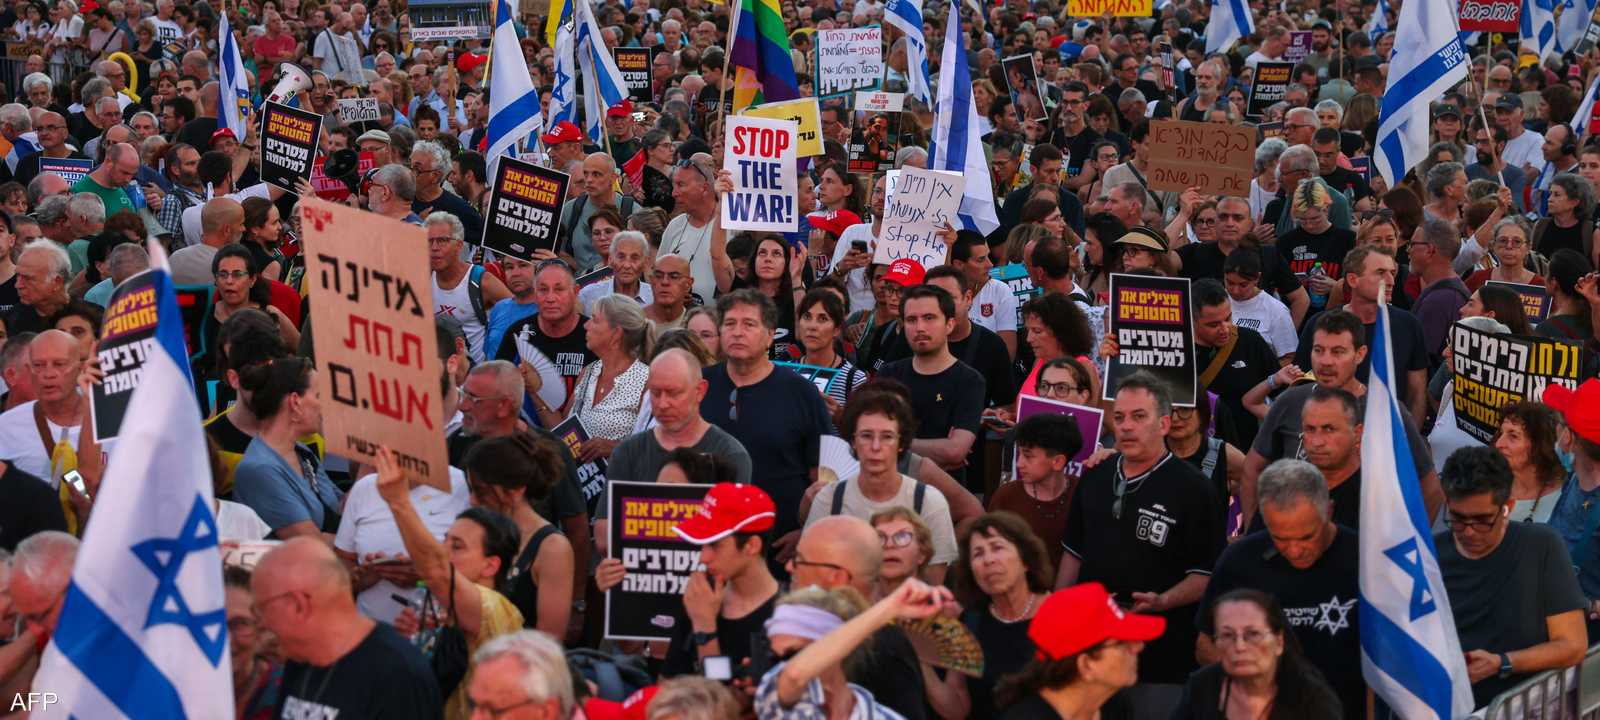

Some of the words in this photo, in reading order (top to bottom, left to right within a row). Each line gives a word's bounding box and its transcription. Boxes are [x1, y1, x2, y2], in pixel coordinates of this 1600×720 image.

[271, 112, 283, 122] את
[284, 115, 313, 132] מצילים
[269, 122, 311, 142] החטופים
[733, 126, 789, 158] STOP
[1155, 127, 1203, 145] מוציא
[266, 138, 309, 160] מסרבים
[266, 150, 306, 173] למלחמה
[505, 170, 522, 183] את
[523, 174, 559, 193] מצילים
[738, 160, 782, 190] THE
[900, 174, 926, 194] חיים
[1218, 172, 1245, 190] את
[503, 180, 555, 205] החטופים
[926, 177, 953, 210] אין
[498, 198, 553, 225] מסרבים
[728, 192, 792, 223] WAR!
[495, 212, 550, 239] למלחמה
[885, 225, 919, 252] Stop
[923, 232, 945, 256] the
[318, 253, 424, 318] מדינה
[1120, 290, 1137, 303] את
[1139, 291, 1180, 306] מצילים
[1120, 304, 1180, 321] החטופים
[343, 313, 423, 371] תחת
[1119, 328, 1184, 348] מסרבים
[1119, 348, 1185, 366] למלחמה
[1455, 327, 1528, 372] הימים
[625, 501, 649, 517] את
[1136, 514, 1169, 547] 89
[622, 572, 690, 594] מלחמה
